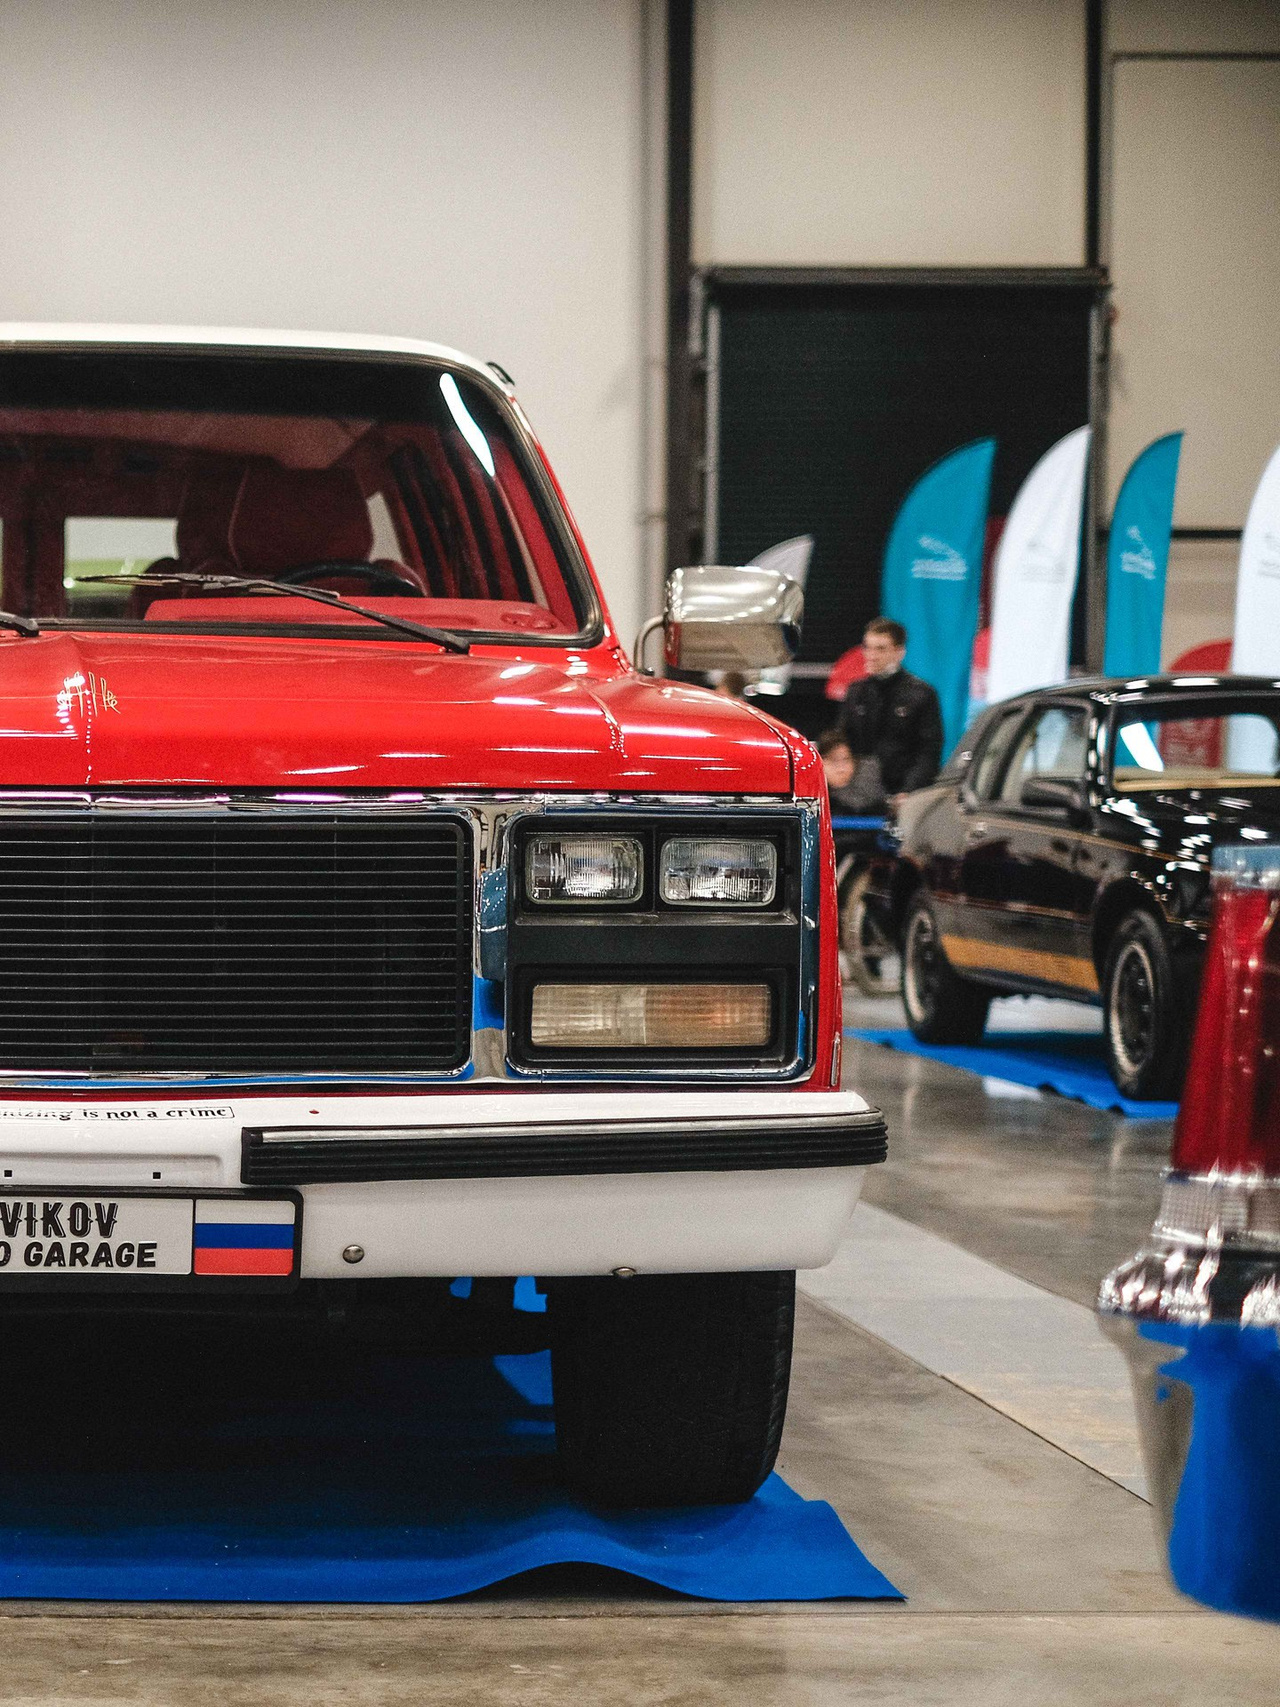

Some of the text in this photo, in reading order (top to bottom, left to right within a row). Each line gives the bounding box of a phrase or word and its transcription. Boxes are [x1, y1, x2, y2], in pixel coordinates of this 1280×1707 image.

[83, 1109, 99, 1118] is
[106, 1109, 140, 1119] not
[147, 1110, 158, 1118] a
[166, 1108, 226, 1118] crime
[23, 1242, 158, 1269] GARAGE
